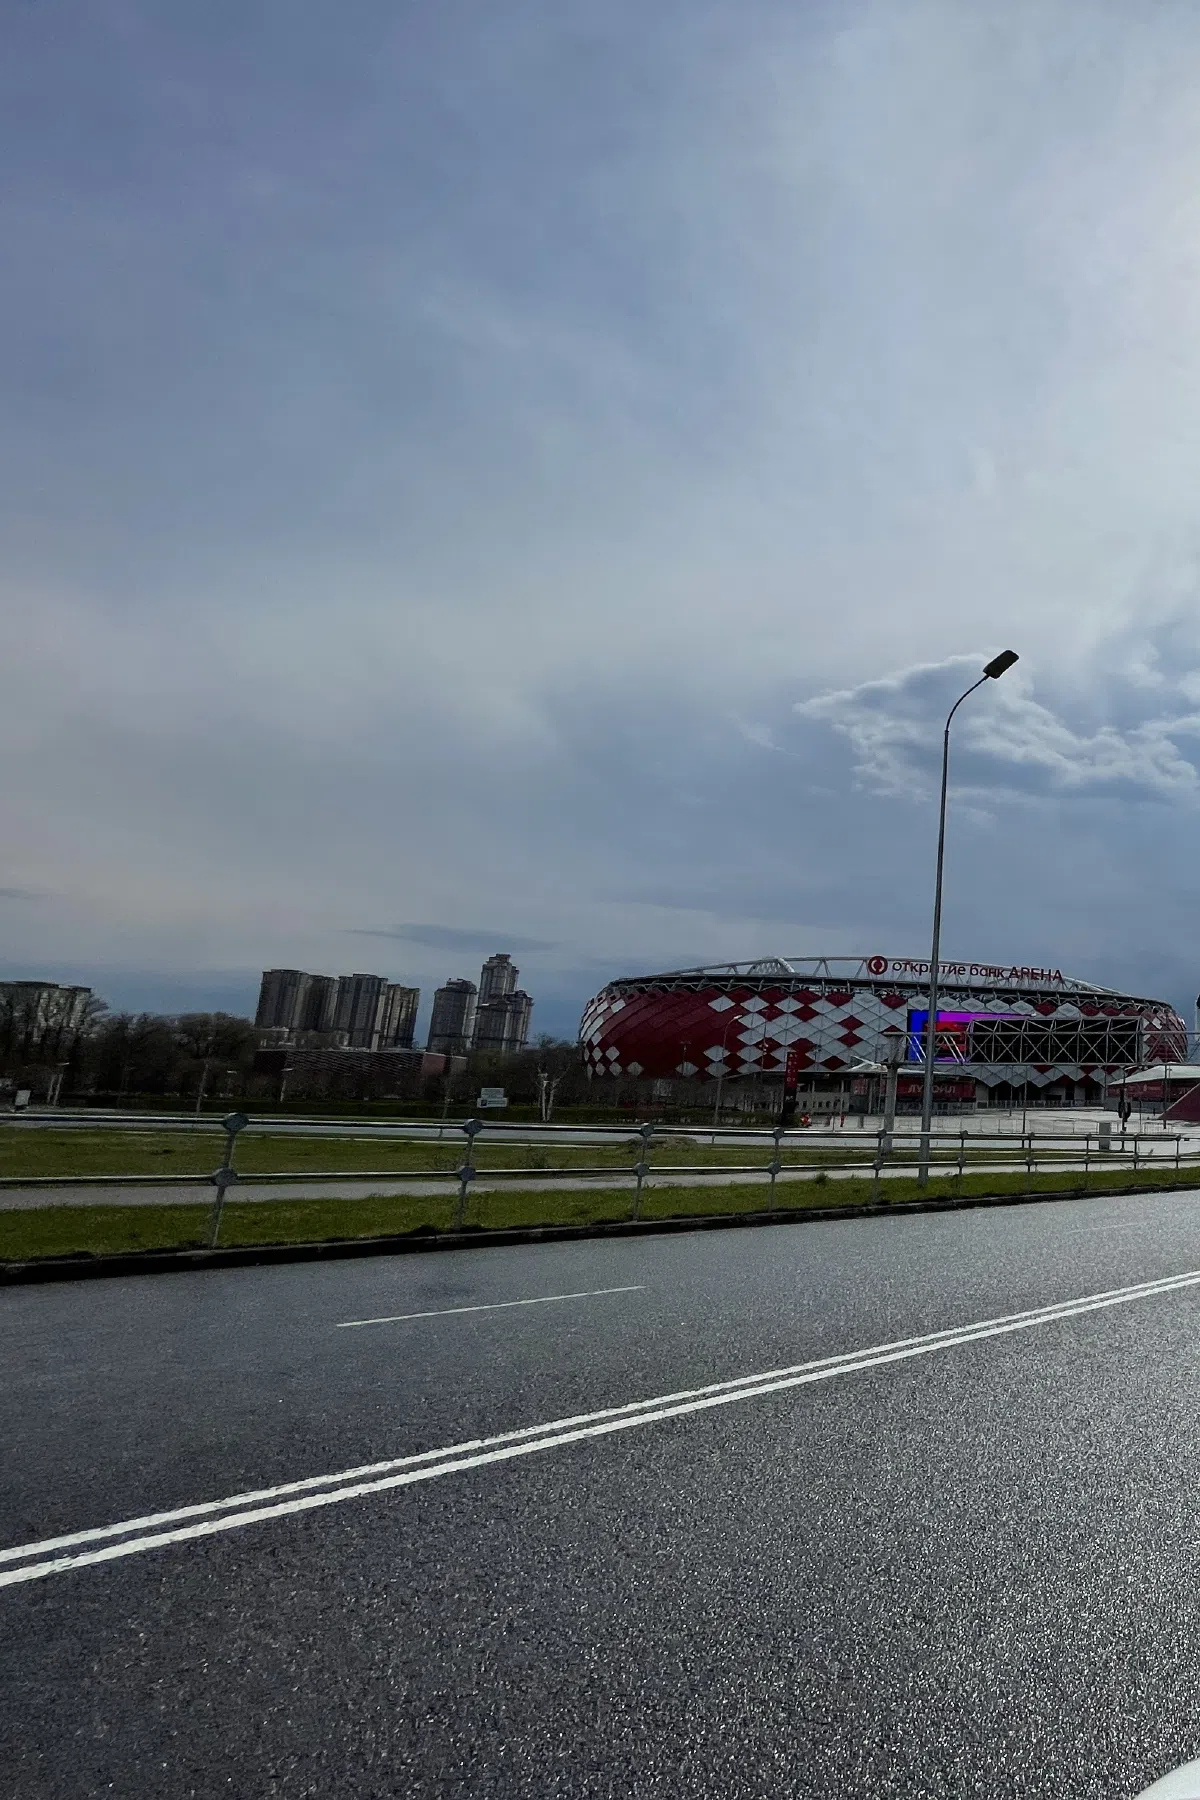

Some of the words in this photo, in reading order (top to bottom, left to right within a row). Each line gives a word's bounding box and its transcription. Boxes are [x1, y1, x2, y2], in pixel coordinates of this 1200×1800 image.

[892, 960, 966, 976] откртие
[969, 963, 1007, 979] банк
[1009, 966, 1063, 982] АРЕНА
[907, 1084, 956, 1094] ЛУОЙЛ
